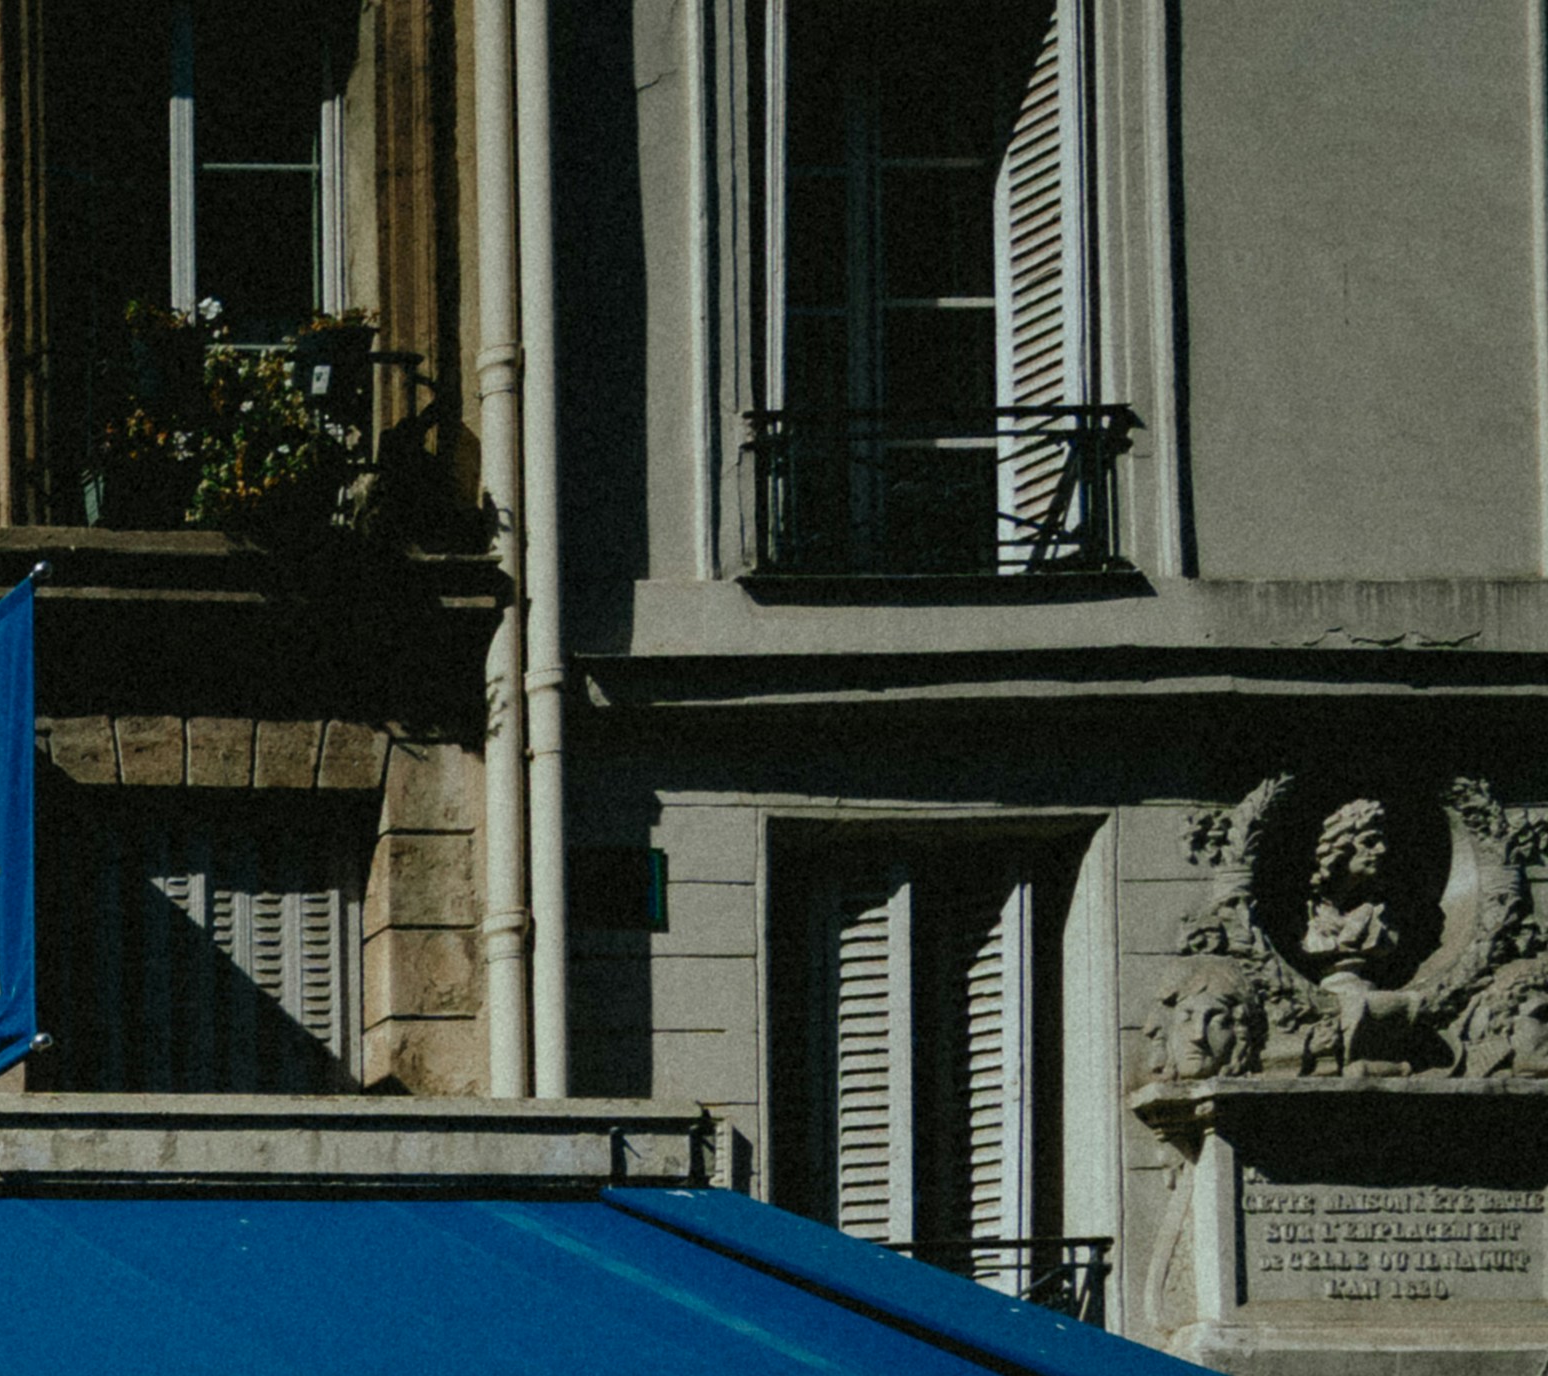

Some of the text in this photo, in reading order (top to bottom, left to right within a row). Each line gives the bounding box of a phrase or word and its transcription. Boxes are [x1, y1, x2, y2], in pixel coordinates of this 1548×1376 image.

[1244, 1193, 1315, 1215] CETTE
[1323, 1192, 1411, 1214] MAISON
[1267, 1222, 1315, 1243] SUR
[1289, 1251, 1369, 1271] CELLE
